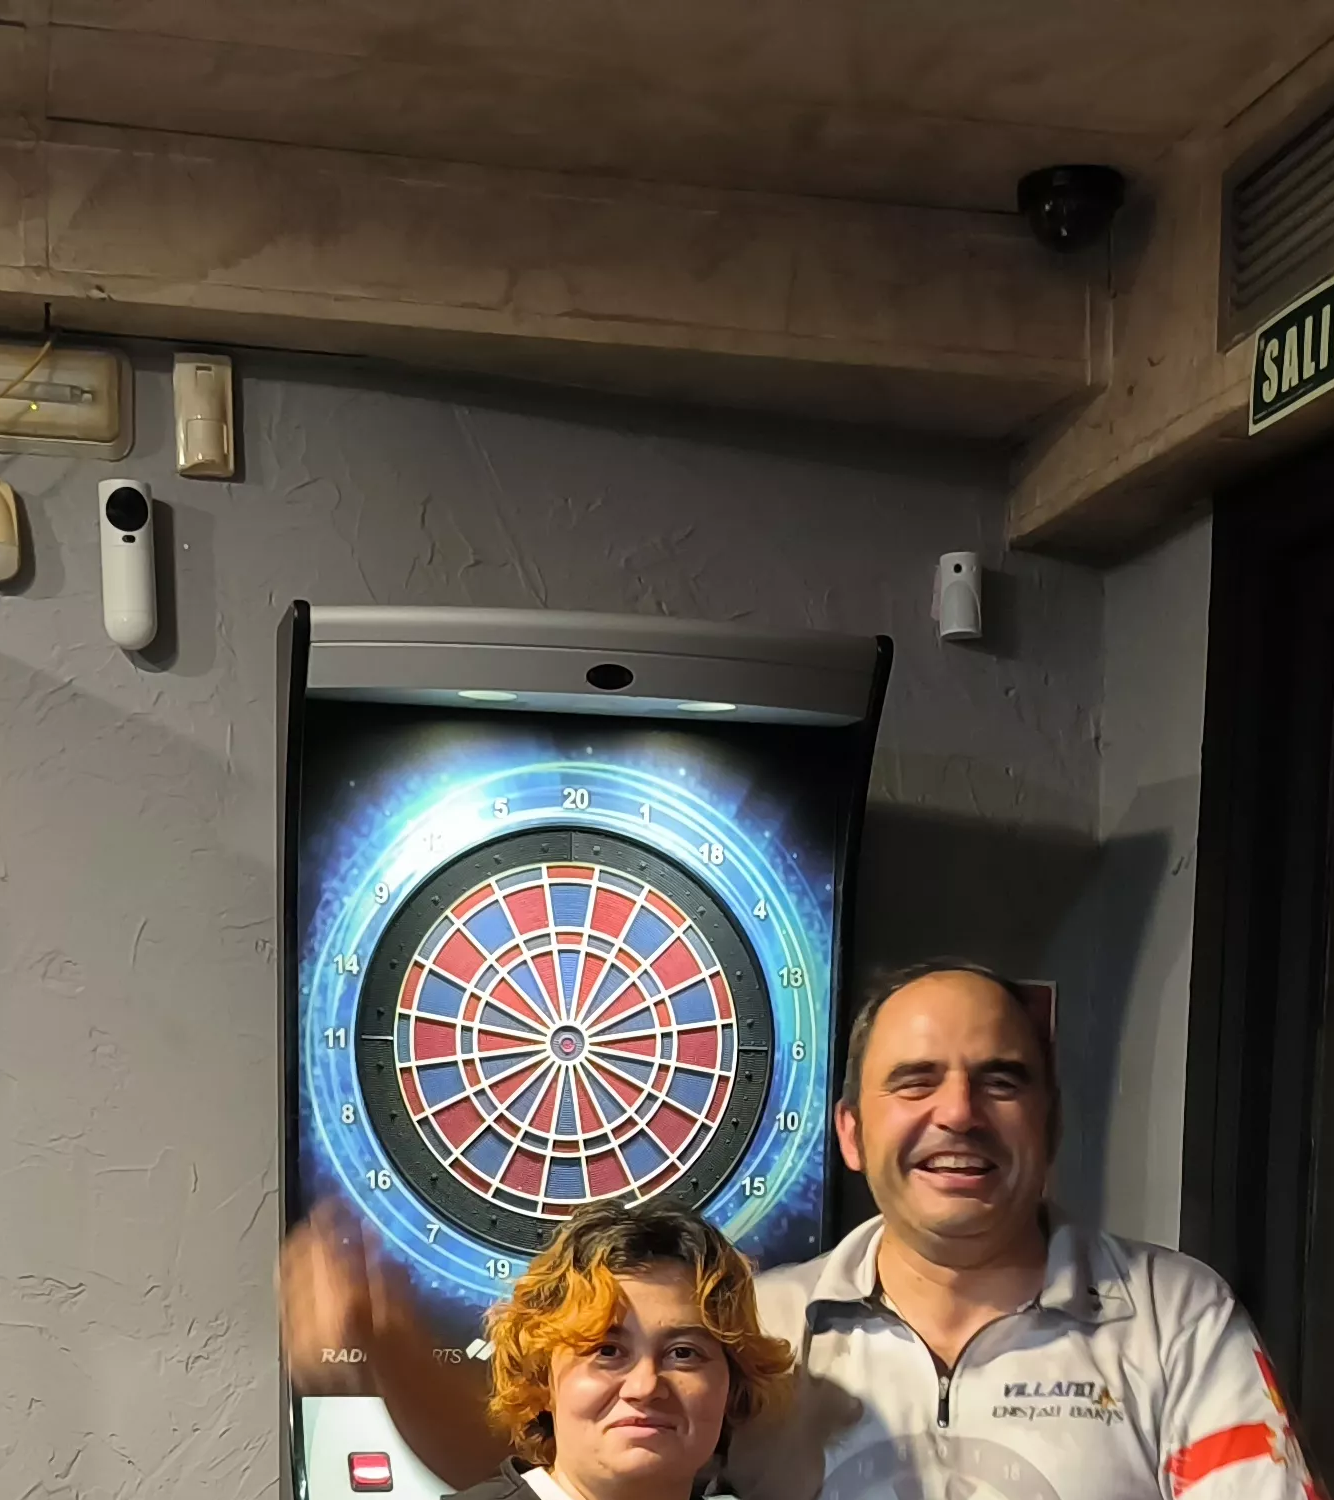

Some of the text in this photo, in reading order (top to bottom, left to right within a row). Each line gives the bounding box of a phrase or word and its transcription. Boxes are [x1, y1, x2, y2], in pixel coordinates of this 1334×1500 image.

[493, 798, 509, 820] 5
[562, 788, 589, 810] 20
[640, 804, 652, 824] 1
[698, 843, 725, 865] 18
[374, 883, 389, 904] 9
[753, 901, 767, 920] 4
[334, 954, 360, 975] 14
[778, 968, 803, 989] 13
[324, 1028, 347, 1048] 11
[791, 1041, 805, 1061] 6
[341, 1104, 355, 1124] 8
[776, 1111, 800, 1131] 10
[366, 1170, 391, 1191] 16
[741, 1176, 766, 1197] 15
[426, 1224, 441, 1244] 7
[485, 1259, 511, 1280] 19
